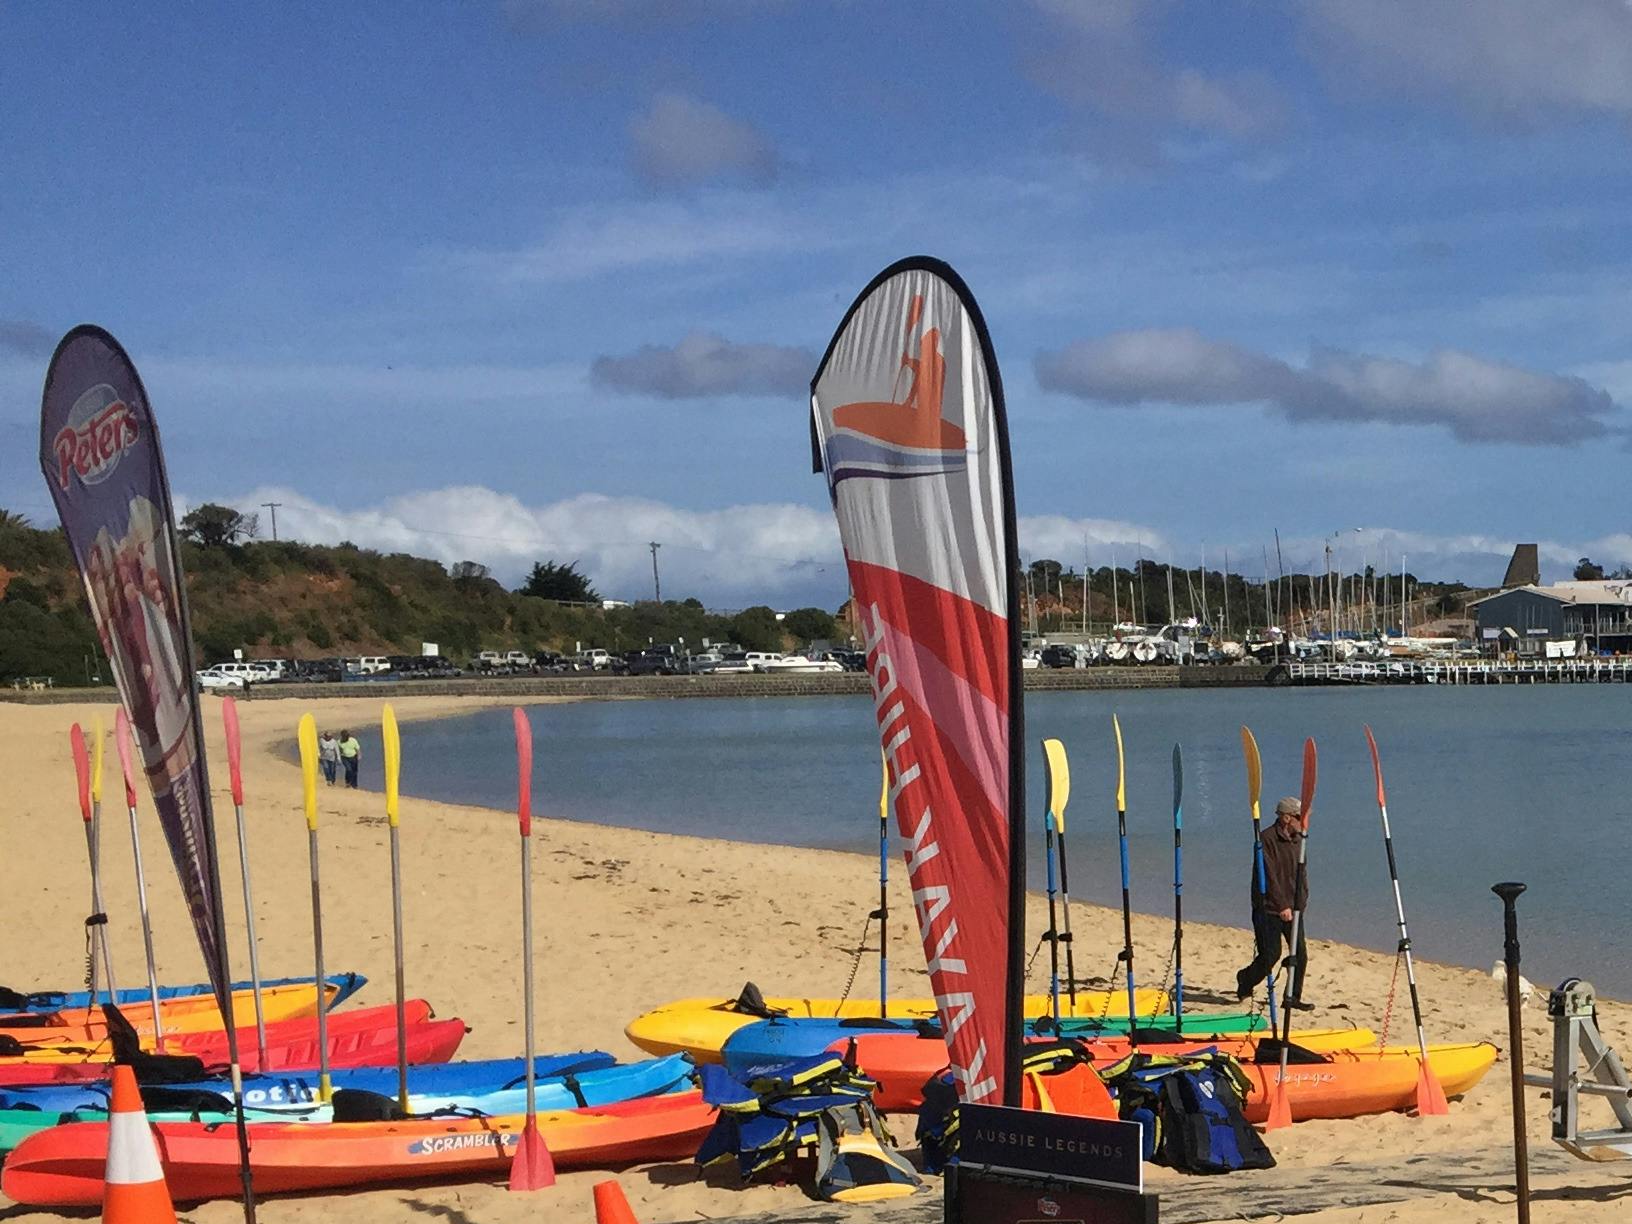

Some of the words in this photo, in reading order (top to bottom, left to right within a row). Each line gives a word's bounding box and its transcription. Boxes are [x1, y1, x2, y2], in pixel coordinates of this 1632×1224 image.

[52, 399, 141, 491] Peters
[975, 1129, 1035, 1147] AUSSIE
[1045, 1137, 1123, 1158] LEGENDS
